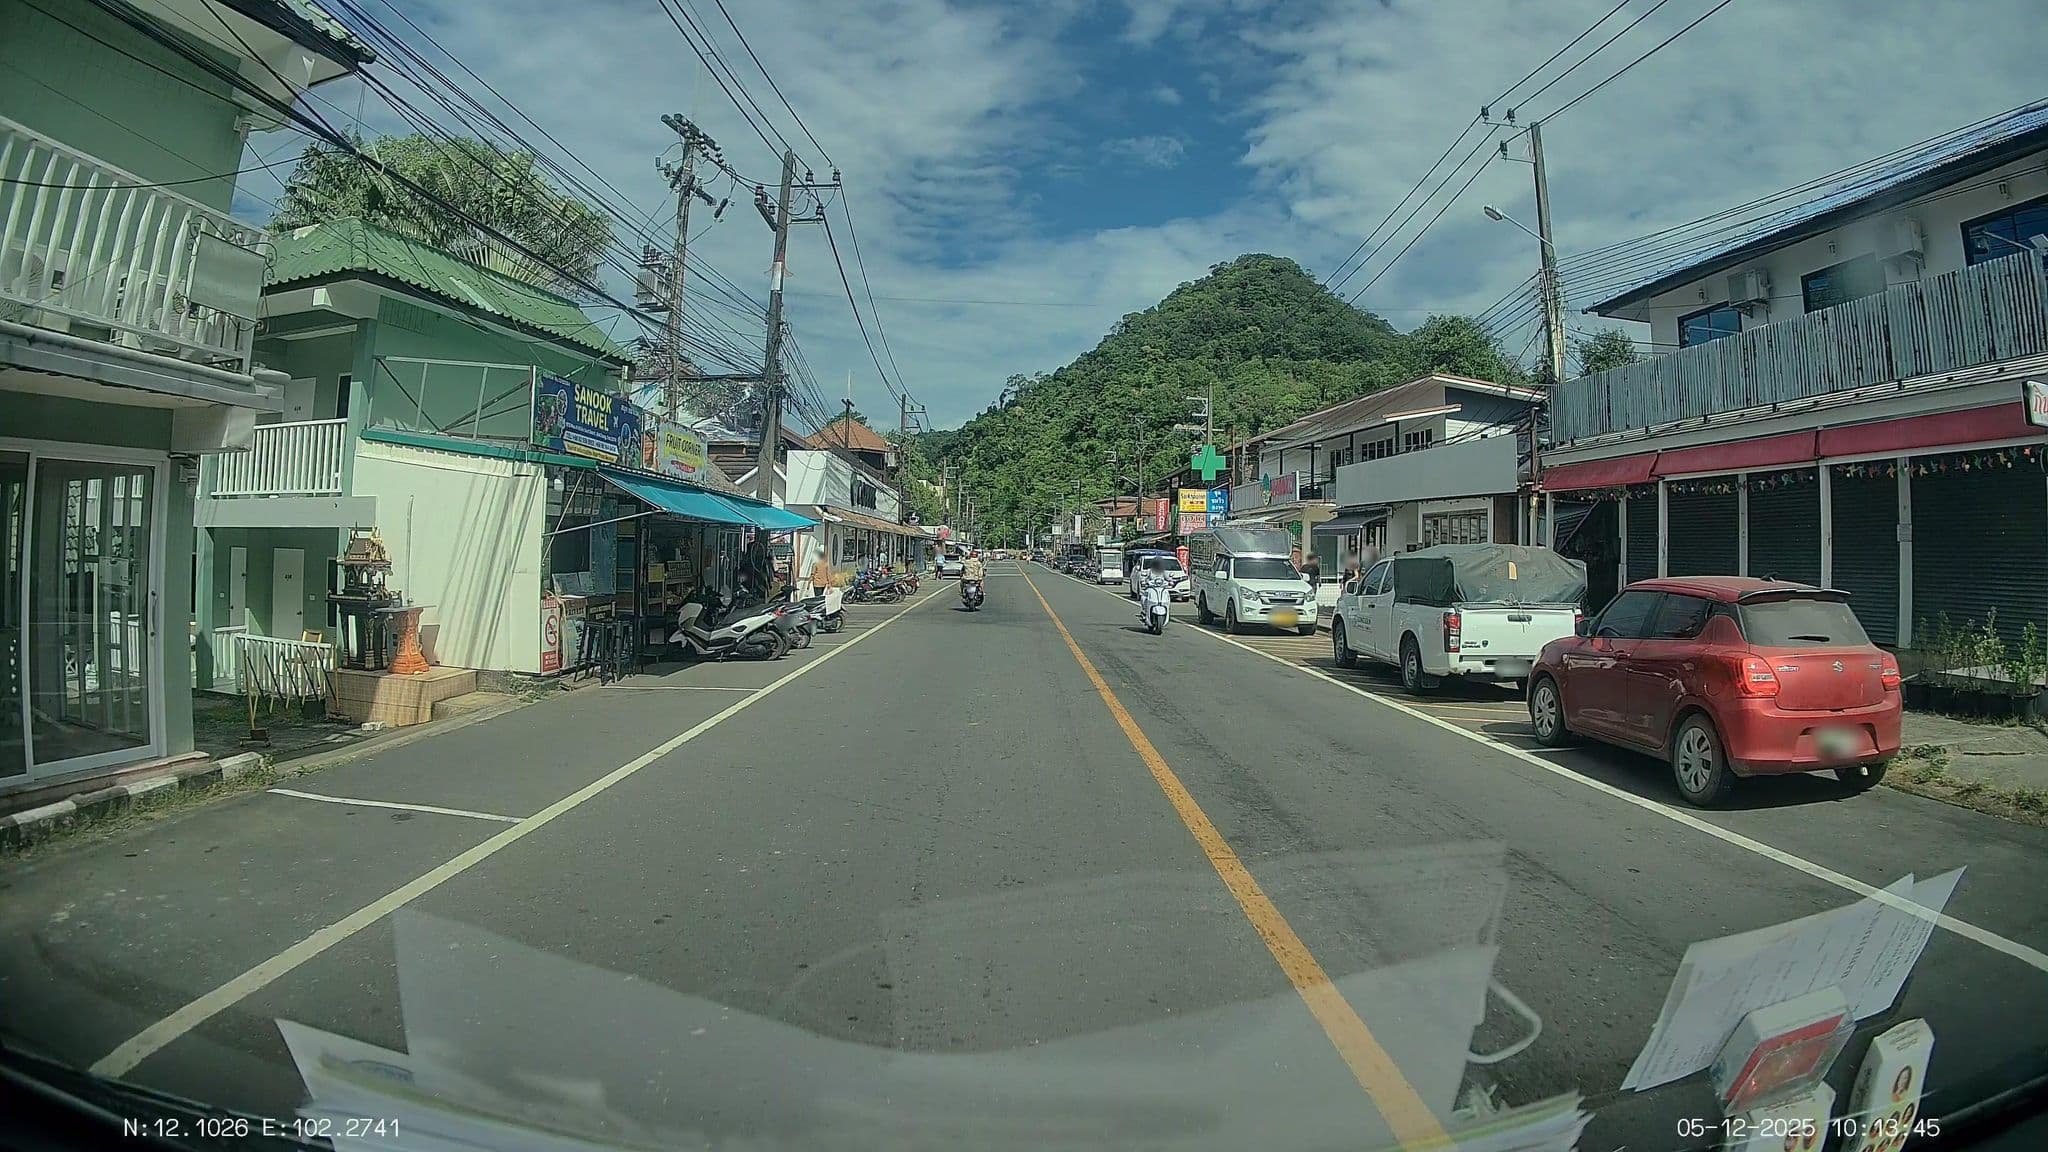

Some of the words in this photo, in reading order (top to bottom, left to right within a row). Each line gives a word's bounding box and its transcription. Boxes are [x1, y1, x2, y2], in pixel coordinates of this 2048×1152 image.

[574, 384, 613, 414] SANOOK
[575, 404, 609, 431] TRAVEL
[665, 433, 681, 450] FRUIT
[681, 440, 701, 457] CORNER
